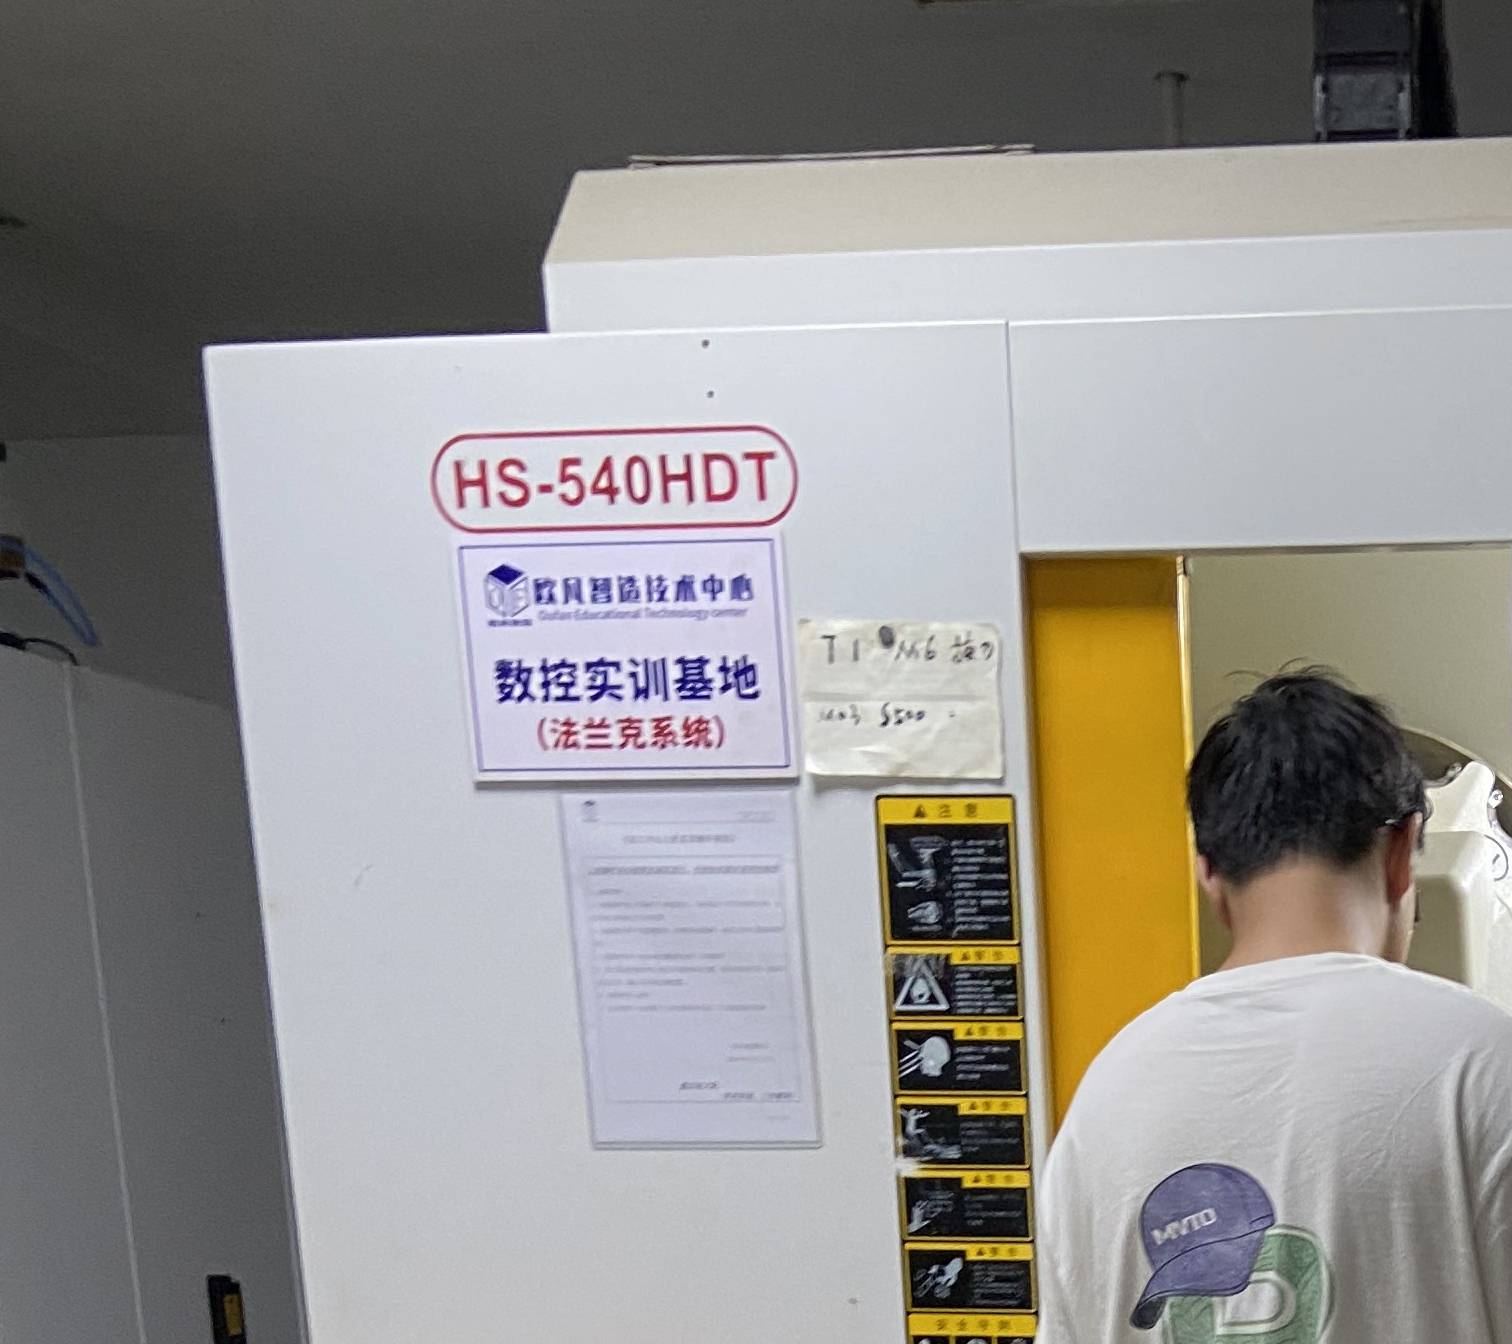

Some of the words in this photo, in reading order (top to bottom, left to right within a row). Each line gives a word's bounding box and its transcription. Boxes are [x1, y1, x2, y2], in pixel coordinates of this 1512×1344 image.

[452, 451, 776, 509] HS-540HDT
[494, 655, 761, 703] 数控实训基地
[537, 716, 726, 751] (法兰克系统)
